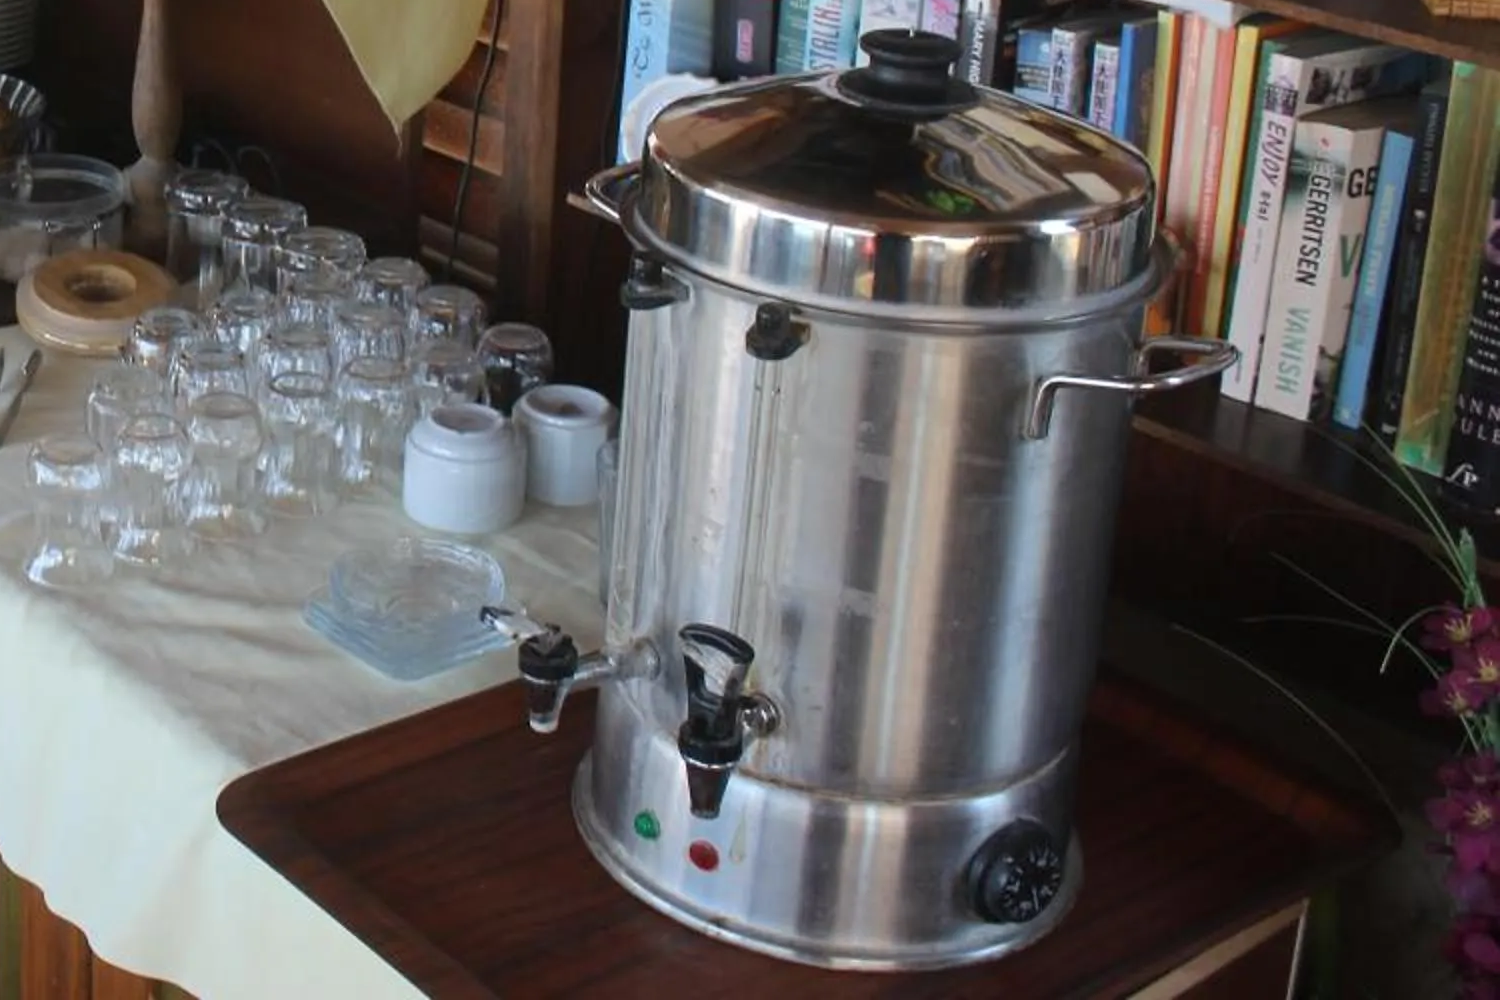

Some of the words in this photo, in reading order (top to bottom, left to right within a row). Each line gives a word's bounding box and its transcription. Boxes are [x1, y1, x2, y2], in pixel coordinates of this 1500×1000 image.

[1262, 120, 1287, 188] ENJOY
[1296, 174, 1331, 288] GERRITSEN
[1275, 306, 1312, 395] VANISH
